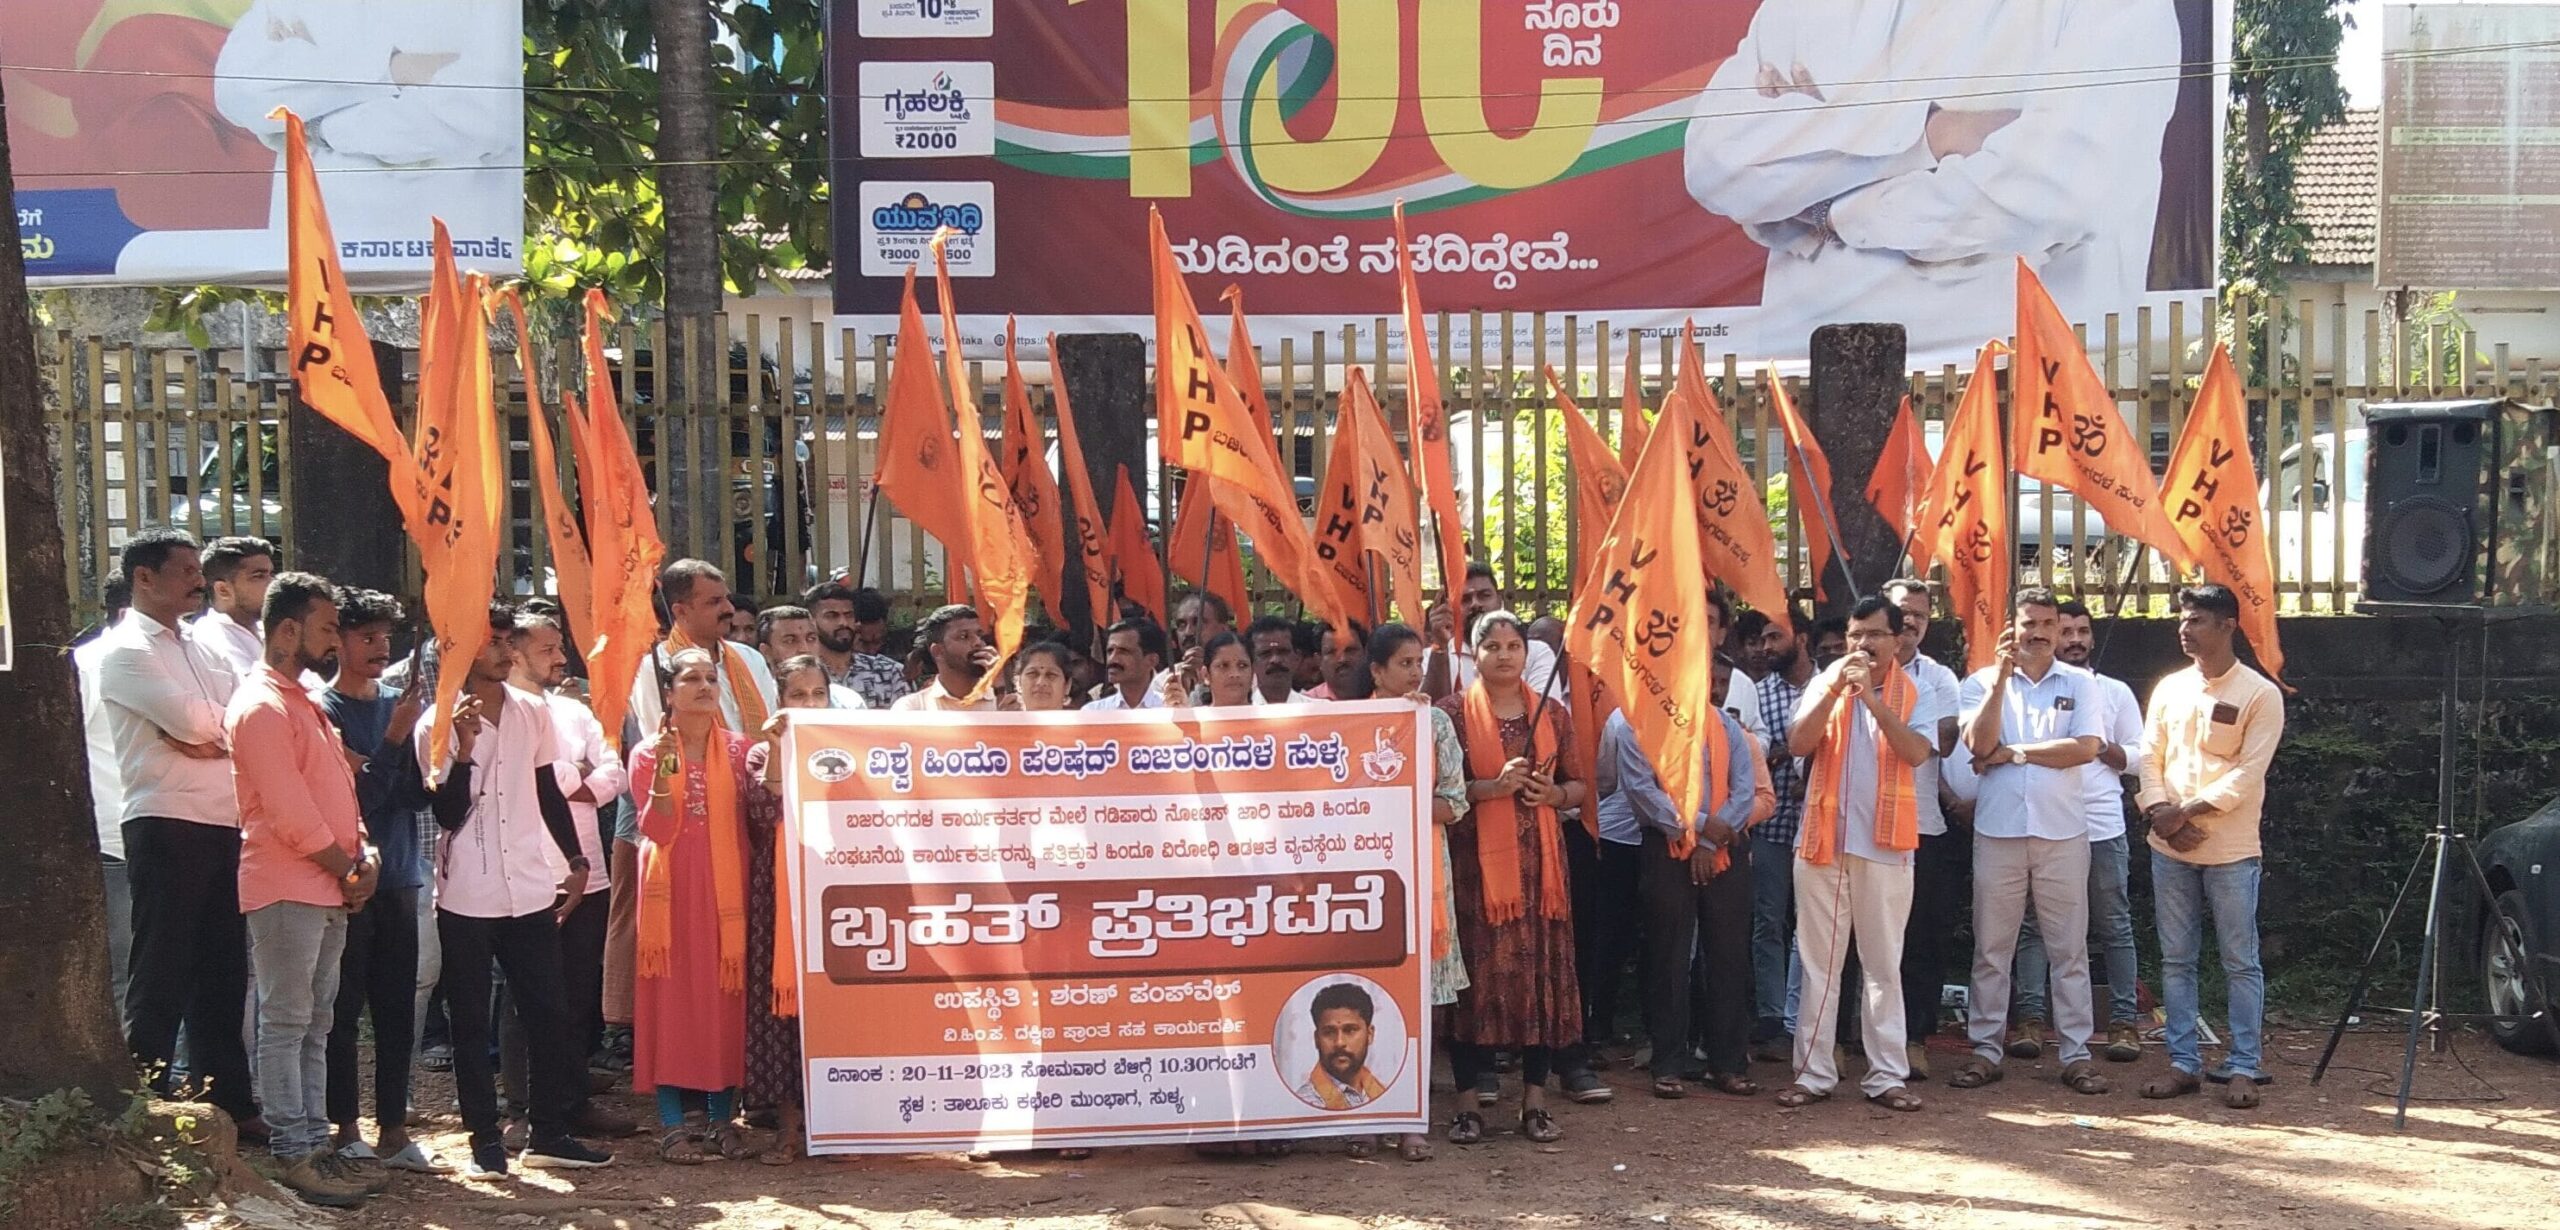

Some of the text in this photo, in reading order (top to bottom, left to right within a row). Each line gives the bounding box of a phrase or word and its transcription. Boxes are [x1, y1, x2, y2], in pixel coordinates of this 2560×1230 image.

[1542, 33, 1603, 67] ದಿನ
[895, 132, 957, 149] ₹2000
[880, 249, 920, 260] ₹3000
[1939, 448, 1988, 528] VHP
[2175, 437, 2234, 524] VHP
[1586, 538, 1658, 632] VHP
[866, 743, 912, 790] ವಿಶ್ವ
[923, 743, 1010, 776] ಹಿಂದೂ
[1021, 739, 1119, 778] ಪರಿಷದ್
[1129, 735, 1275, 771] ಬಜರಂಗದಳ
[1287, 733, 1350, 781] ಸುಳ್ಯ
[846, 797, 1371, 829] ಬಜರಂಗದಳ ಕಾರ್ಯಕರ್ತರ ಮೇಲೆ ಗಡಿಪಾರು ನೋಟಿಸ್ ಜಾರಿ ಮಾಡಿ ಹಿಂದೂ
[824, 846, 905, 867] ಸಂಘಟನೆಯ
[913, 844, 1037, 870] ಕಾರ್ಯಕರ್ತರನ್ನು
[1105, 840, 1154, 859] ಹಿಂದೂ
[1161, 839, 1220, 860] ವಿರೋಧಿ
[1227, 836, 1277, 856] ಆಡಳಿತ
[1284, 833, 1347, 865] ವ್ಯವಸ್ಥೆಯ
[1354, 831, 1394, 861] ವಿರುದ್ಧ
[829, 874, 1386, 972] ಬೃಹತ್ ಪ್ರತಿಭಟನೆ
[934, 986, 1021, 1022] ಉಪಸ್ಥಿತಿ
[1049, 983, 1118, 1006] ಶರಣ್
[1014, 1023, 1056, 1047] ದಕ್ಷಿಣ
[1062, 1021, 1111, 1043] ಪ್ರಾಂತ
[1118, 1020, 1147, 1037] ಸಹ
[1153, 1017, 1247, 1037] ಕಾರ್ಯದರ್ಶಿ
[827, 1065, 884, 1083] ದಿನಾಂಕ
[901, 1063, 1014, 1082] 20-11-2023
[1020, 1057, 1107, 1078] ಸೋಮವಾರ
[1113, 1056, 1153, 1083] ಬೆಳಿಗ್ಗೆ
[1159, 1052, 1257, 1074] 10.30ಗಂಟೆಗೆ
[898, 1096, 925, 1124] ಸ್ಥಳ
[943, 1095, 1009, 1112] ತಾಲೂಕು
[1070, 1089, 1143, 1110] ಮುಂಭಾಗ,
[1149, 1086, 1186, 1115] ಸುಳ್ಯ
